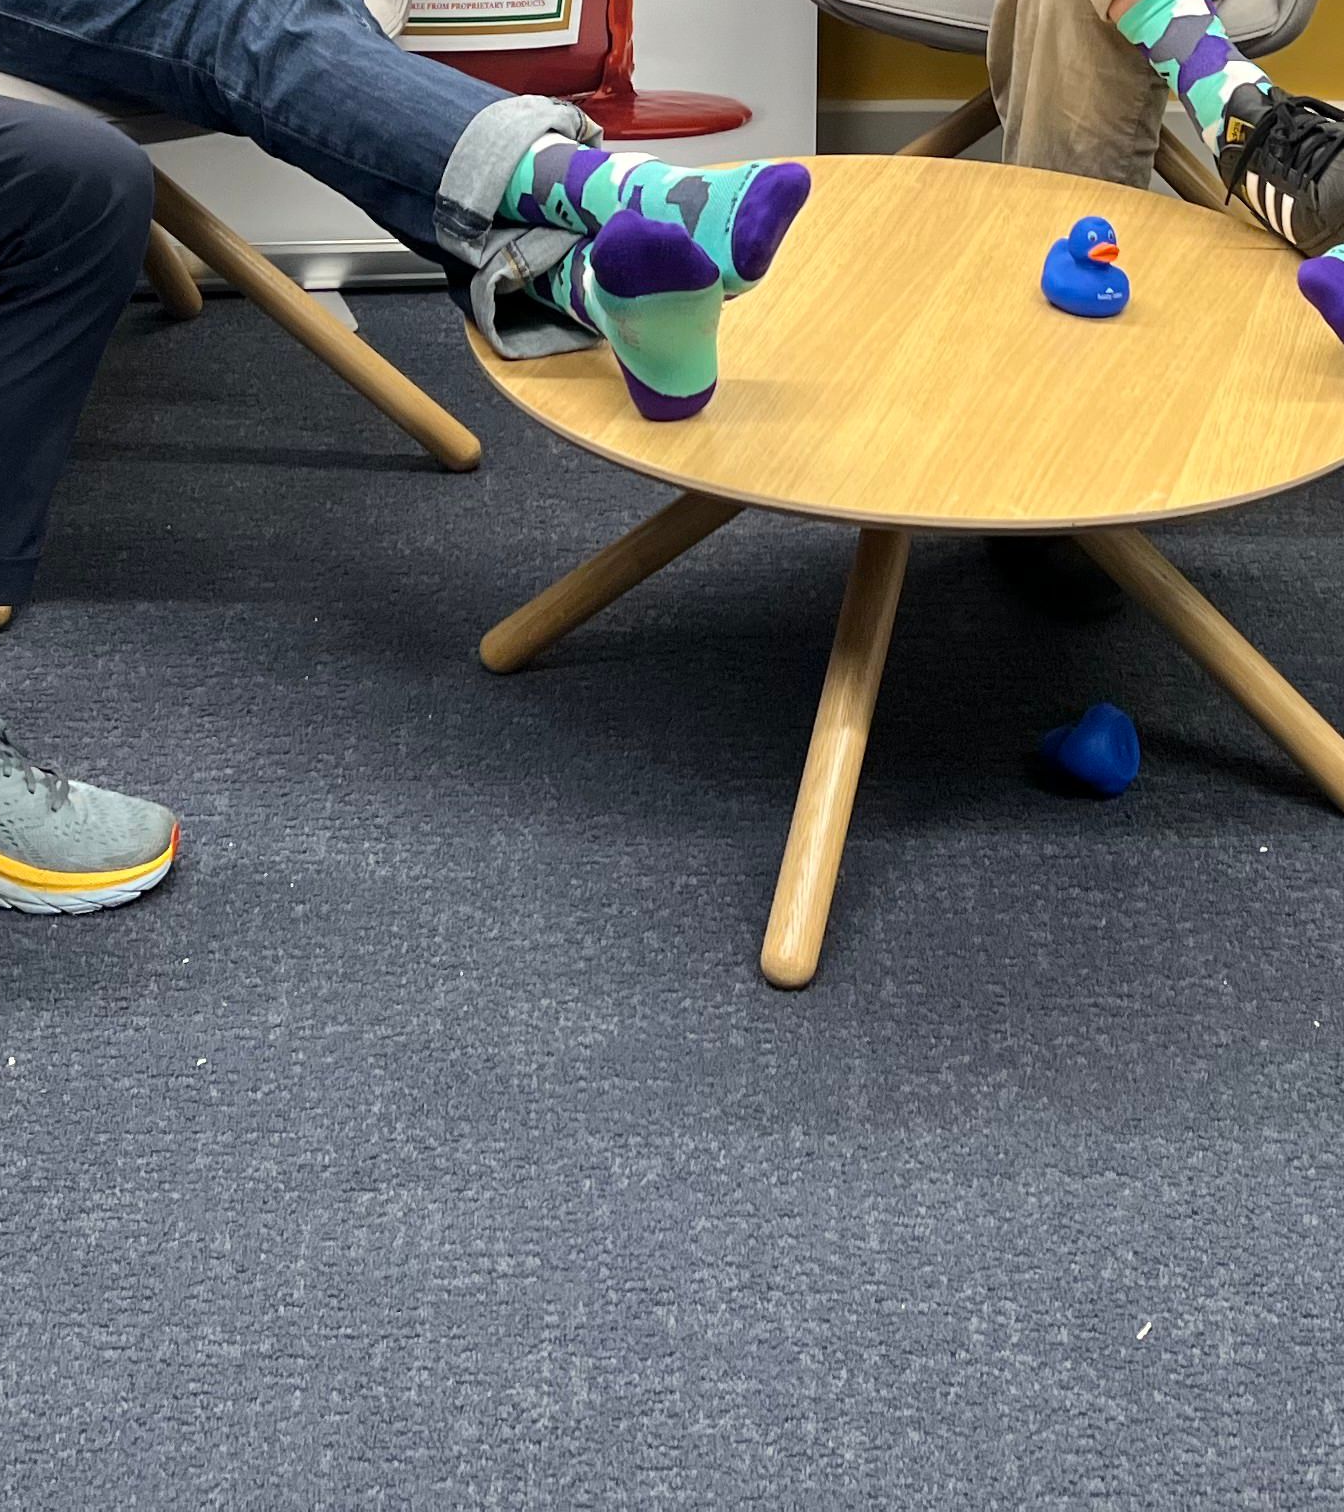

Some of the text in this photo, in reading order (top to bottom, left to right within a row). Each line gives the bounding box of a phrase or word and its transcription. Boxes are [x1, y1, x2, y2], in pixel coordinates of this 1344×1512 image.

[427, 1, 450, 10] FROM
[451, 1, 504, 10] PROPRIETARY
[506, 0, 546, 9] PRODUCTS
